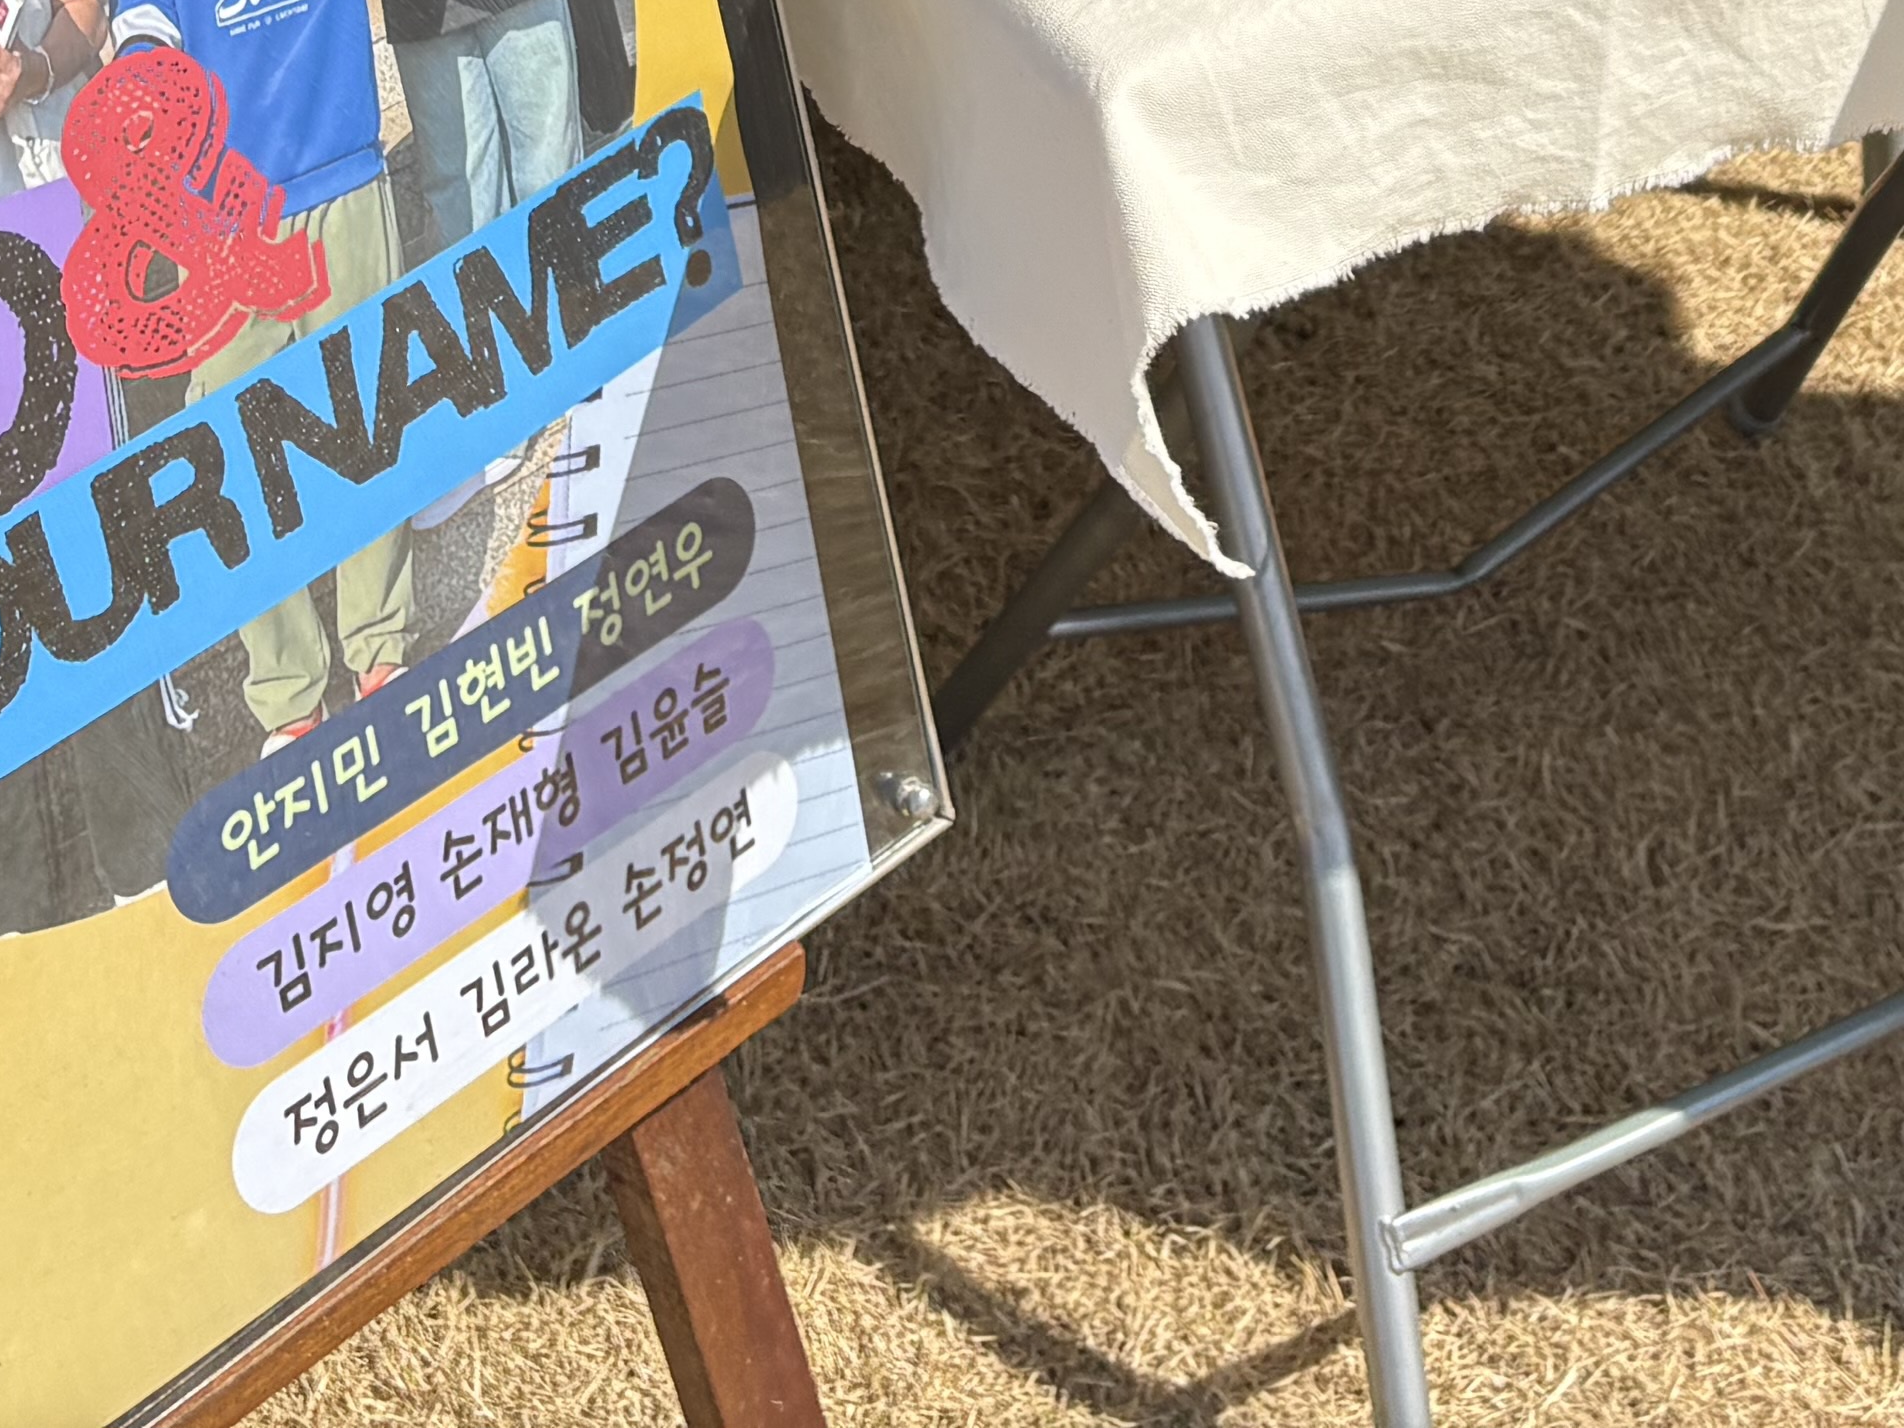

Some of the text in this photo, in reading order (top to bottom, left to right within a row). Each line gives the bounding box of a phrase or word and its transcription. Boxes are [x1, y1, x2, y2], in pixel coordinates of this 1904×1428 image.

[62, 44, 331, 378] &
[236, 105, 715, 540] NAME?
[221, 520, 714, 873] 안지민 김현빈 정연우
[257, 662, 732, 1013] 김지영 손재형 김윤슬
[283, 786, 756, 1153] 정은서 김라온 손정연
